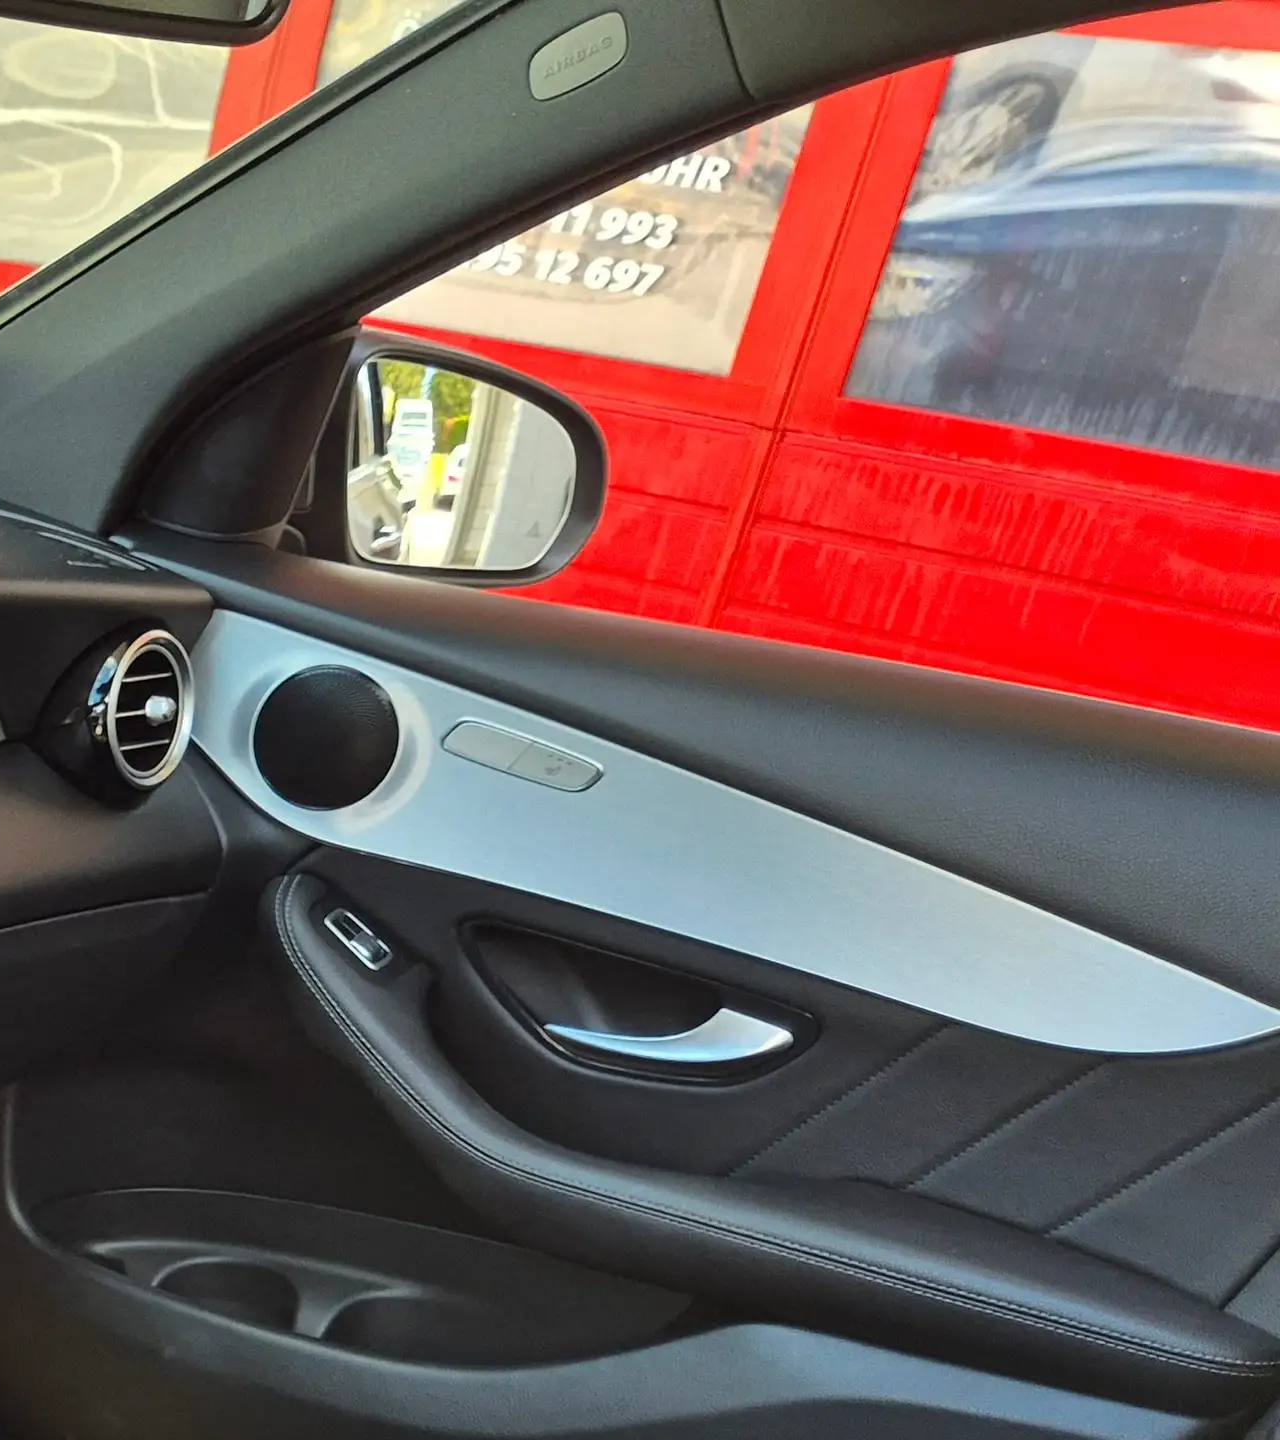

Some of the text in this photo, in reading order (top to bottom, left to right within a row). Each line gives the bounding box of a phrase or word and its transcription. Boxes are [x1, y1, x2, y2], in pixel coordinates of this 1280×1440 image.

[595, 207, 678, 249] 993
[535, 250, 579, 285] 12
[583, 256, 664, 296] 697
